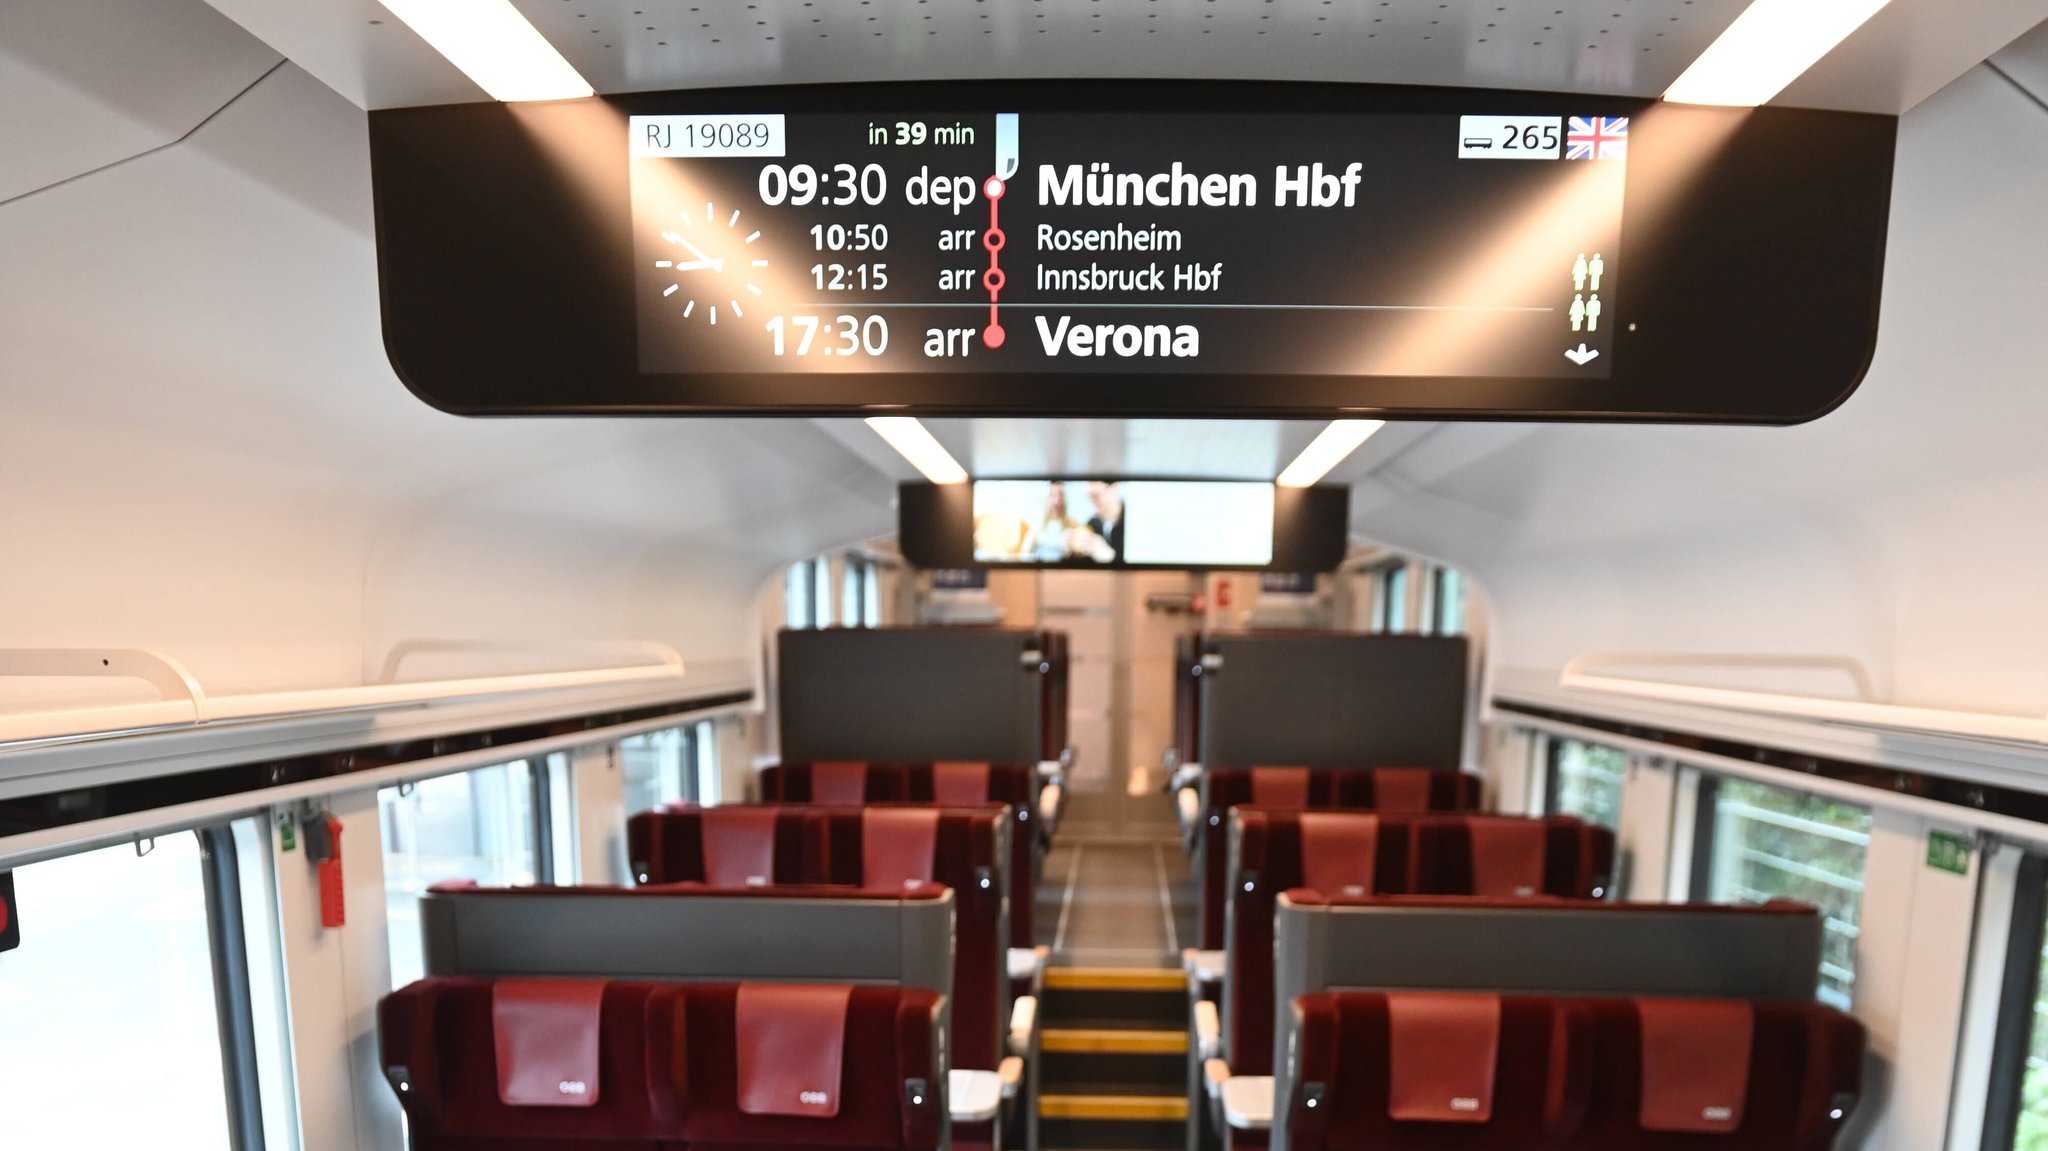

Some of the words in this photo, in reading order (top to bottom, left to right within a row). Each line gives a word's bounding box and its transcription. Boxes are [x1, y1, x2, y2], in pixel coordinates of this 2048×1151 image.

[647, 124, 671, 149] RJ
[685, 123, 770, 149] 19089
[869, 122, 887, 145] in
[895, 122, 927, 145] 39
[935, 122, 974, 145] min
[1503, 125, 1558, 149] 265
[758, 164, 887, 206] 09:30
[905, 165, 976, 215] dep
[1038, 162, 1257, 206] München
[1275, 163, 1363, 207] Hbf
[810, 224, 889, 251] 10:50
[938, 229, 975, 251] arr
[1037, 223, 1182, 251] Rosenheim
[810, 264, 889, 290] 12:15
[938, 269, 975, 290] arr
[1037, 263, 1165, 291] Innsbruck
[1173, 263, 1223, 291] Hbf
[765, 315, 889, 356] 17:30
[924, 327, 975, 357] arr
[1034, 315, 1199, 357] Verona
